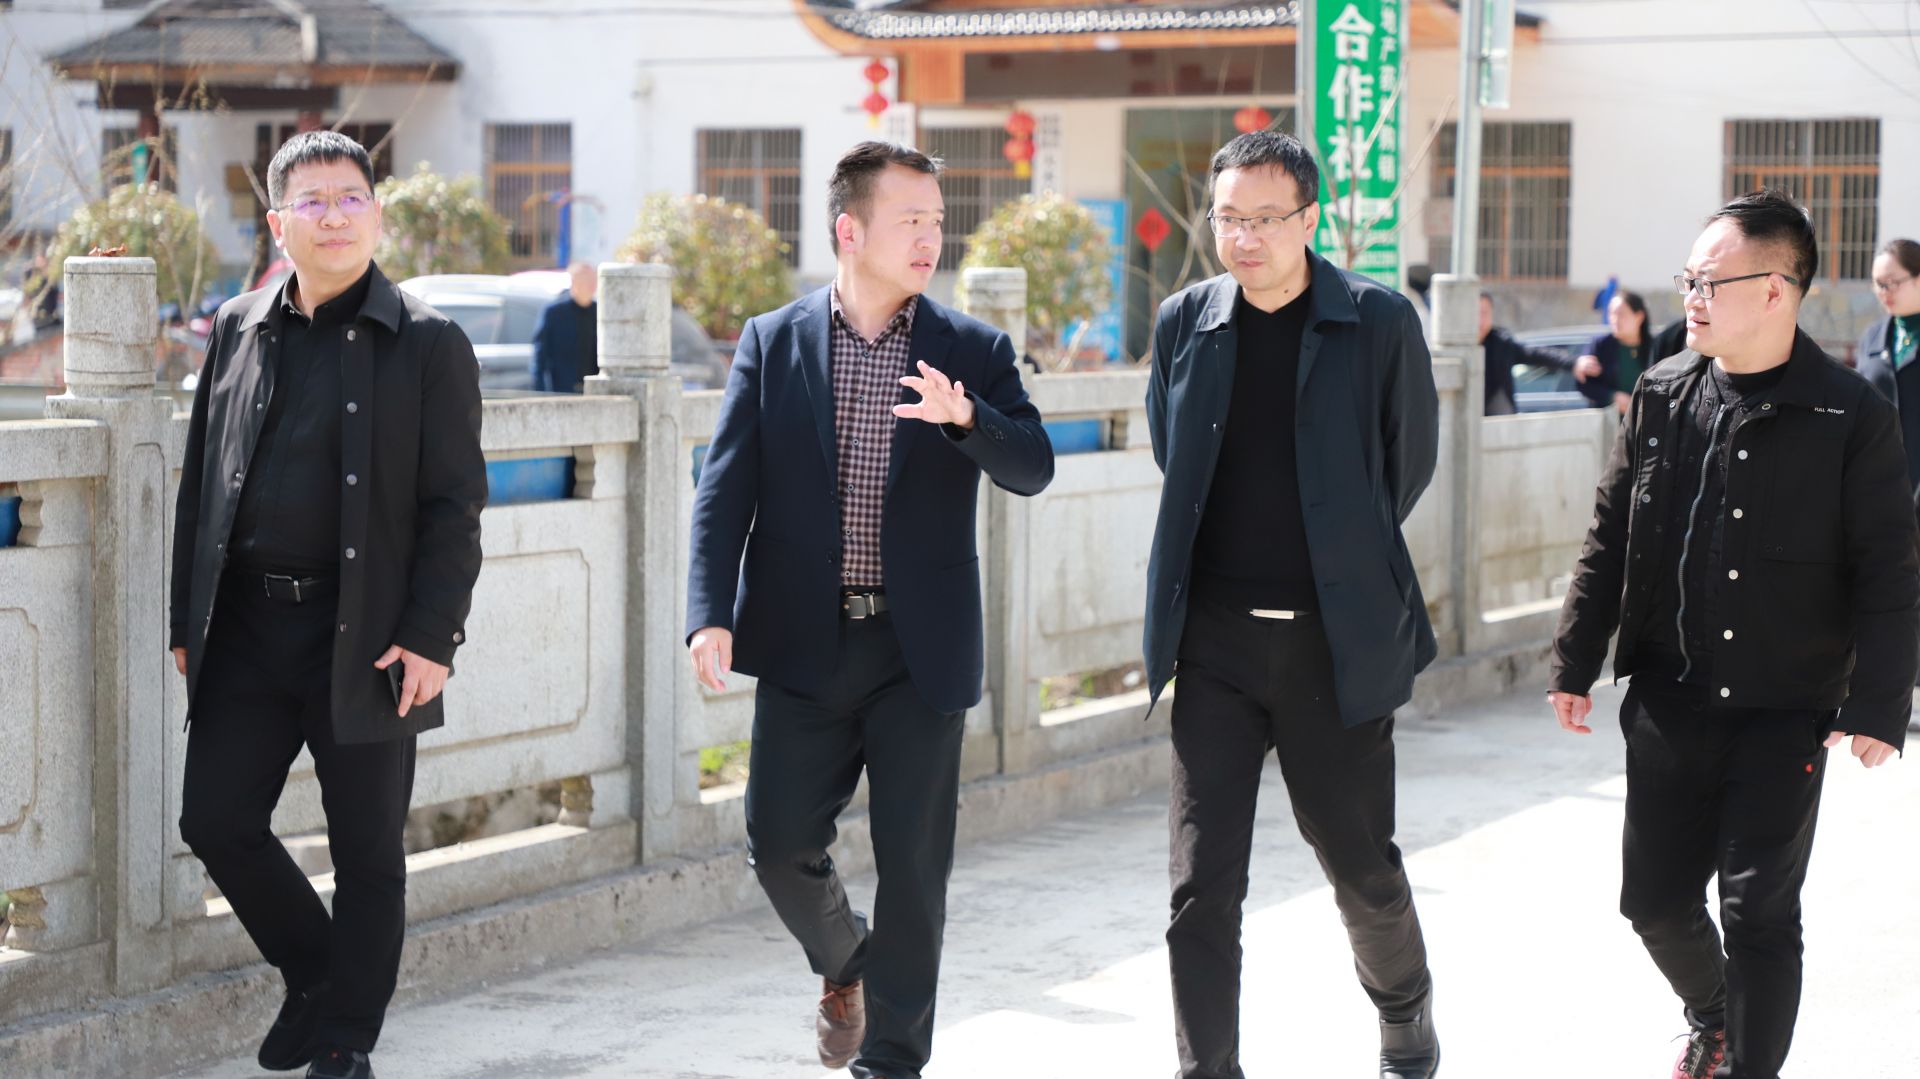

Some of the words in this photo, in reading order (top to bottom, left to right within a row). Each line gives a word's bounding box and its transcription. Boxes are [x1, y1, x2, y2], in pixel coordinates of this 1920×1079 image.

[1327, 4, 1375, 182] 合作社
[1827, 407, 1845, 415] ACTION
